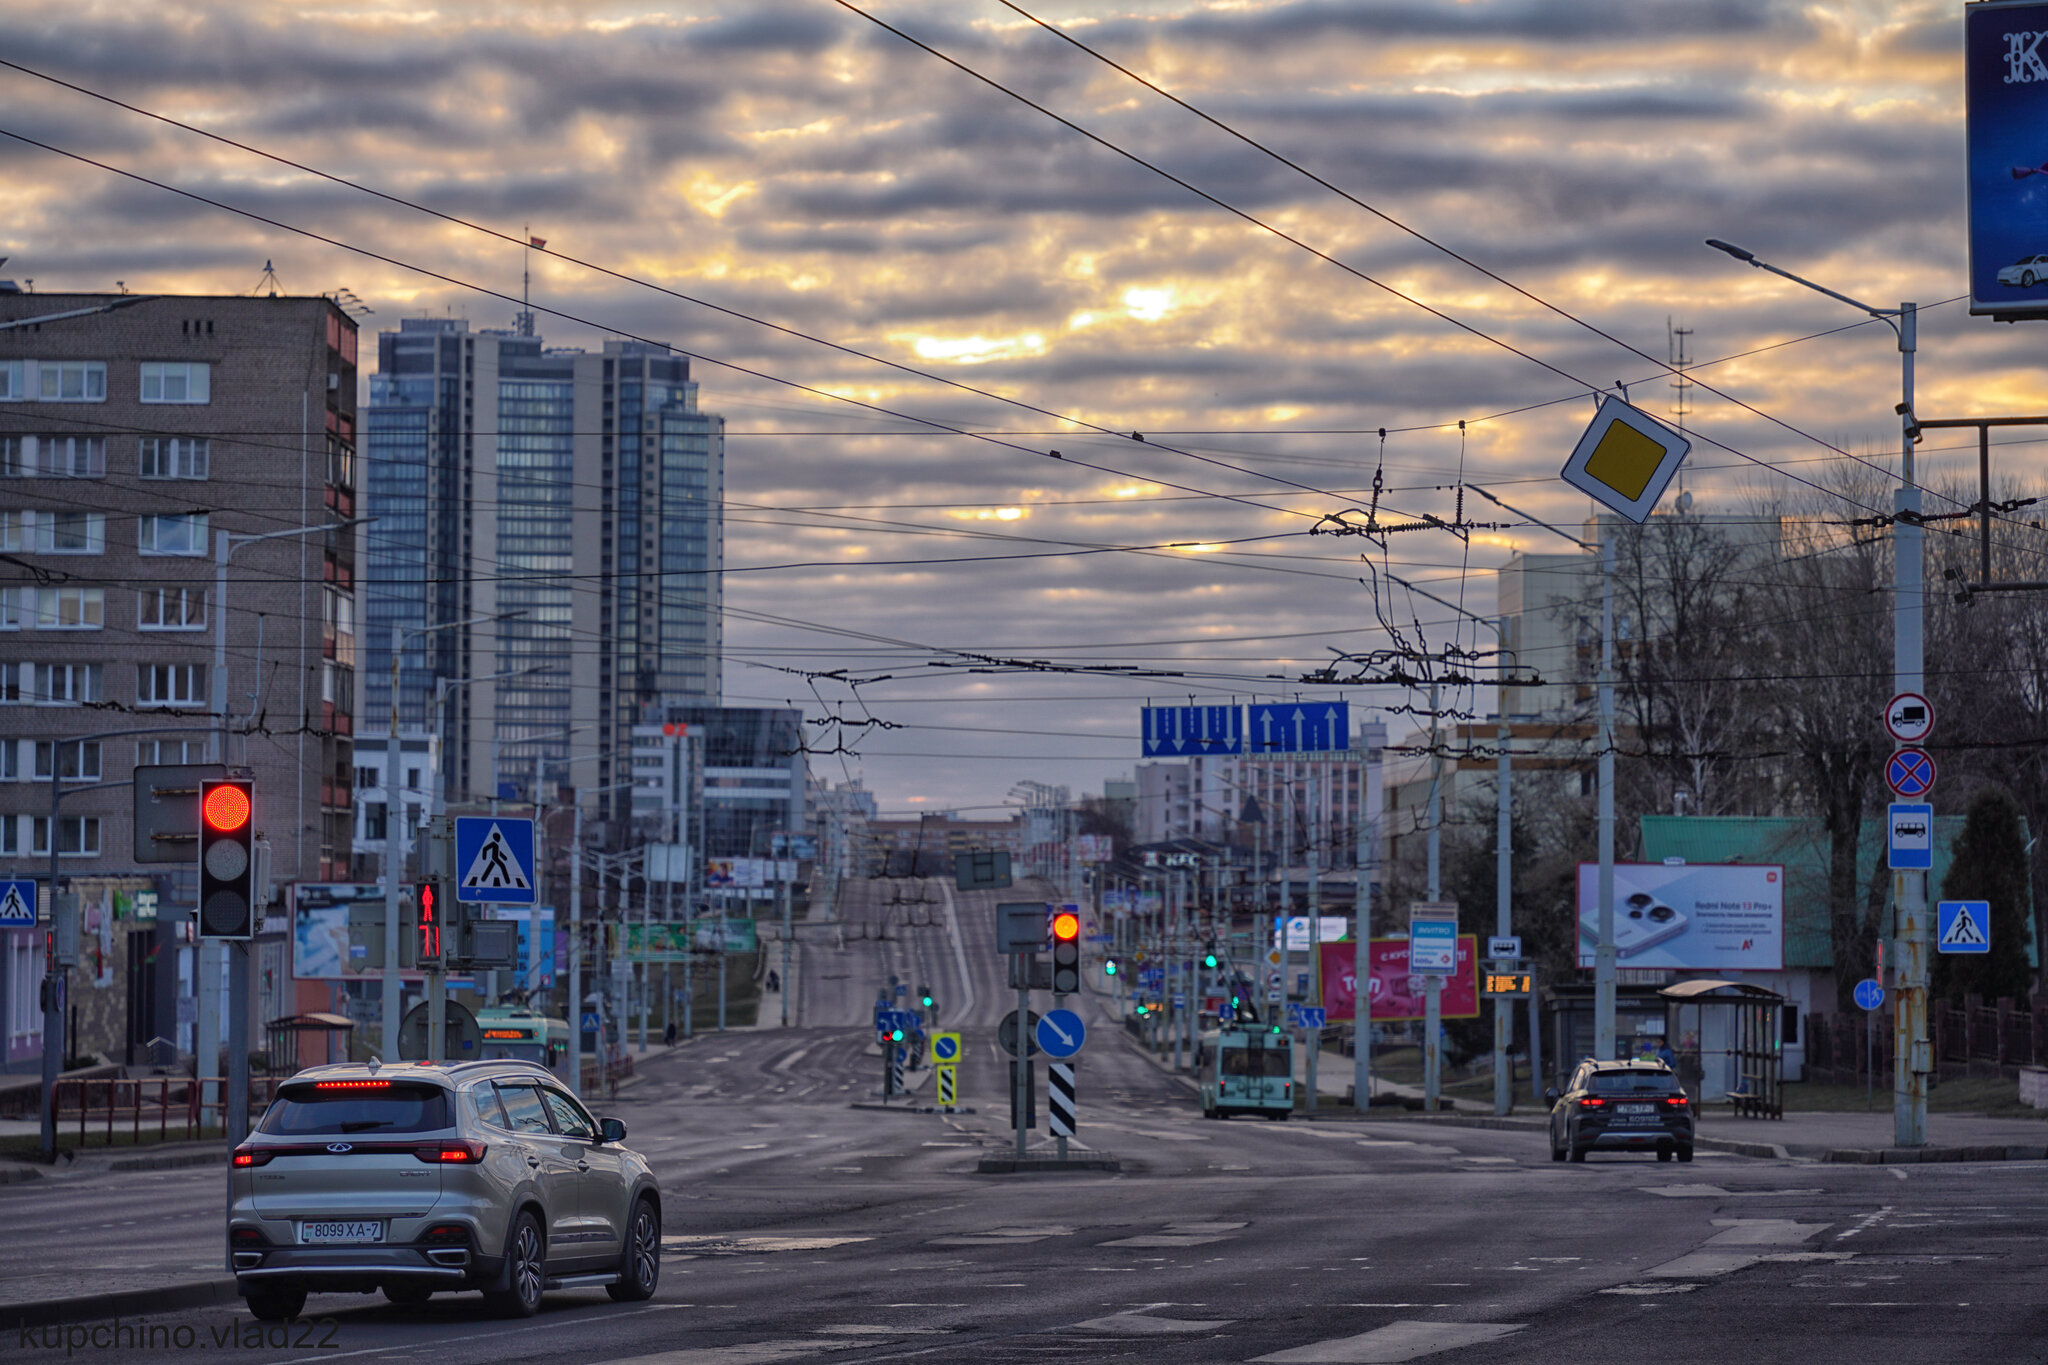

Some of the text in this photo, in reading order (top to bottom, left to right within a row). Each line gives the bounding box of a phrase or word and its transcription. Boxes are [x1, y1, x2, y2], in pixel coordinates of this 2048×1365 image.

[662, 723, 688, 736] OZ
[1166, 854, 1198, 866] KFC
[1695, 902, 1772, 910] Redmi Note 13 Pro+
[1417, 927, 1450, 935] INVITRO
[1343, 976, 1380, 993] ТП
[315, 1223, 379, 1237] 8099 XA-7
